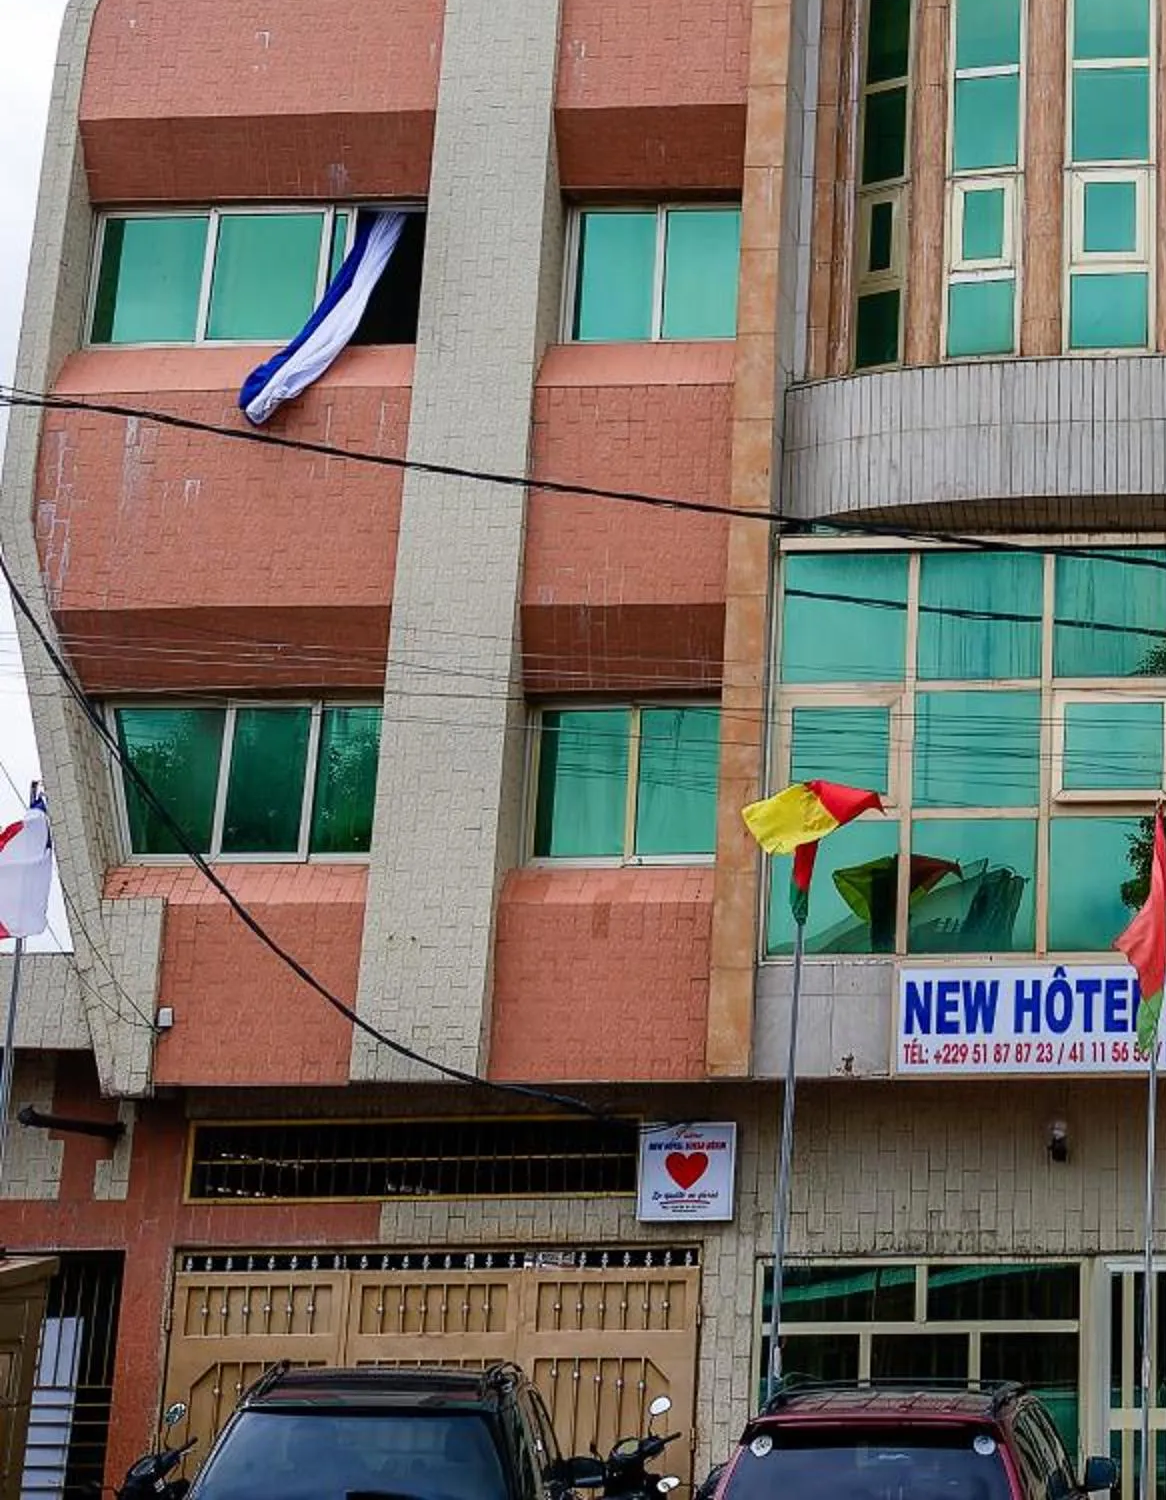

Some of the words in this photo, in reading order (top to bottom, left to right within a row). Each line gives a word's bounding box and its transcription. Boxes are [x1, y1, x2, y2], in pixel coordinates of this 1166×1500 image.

[903, 979, 1000, 1035] NEW
[903, 1038, 929, 1065] TÉL:
[933, 1044, 969, 1065] +229
[972, 1044, 988, 1065] 51
[993, 1044, 1011, 1065] 87
[1014, 1044, 1032, 1065] 87
[1035, 1044, 1054, 1065] 23
[1068, 1043, 1086, 1064] 41
[1091, 1042, 1106, 1063] 11
[1111, 1042, 1129, 1063] 56
